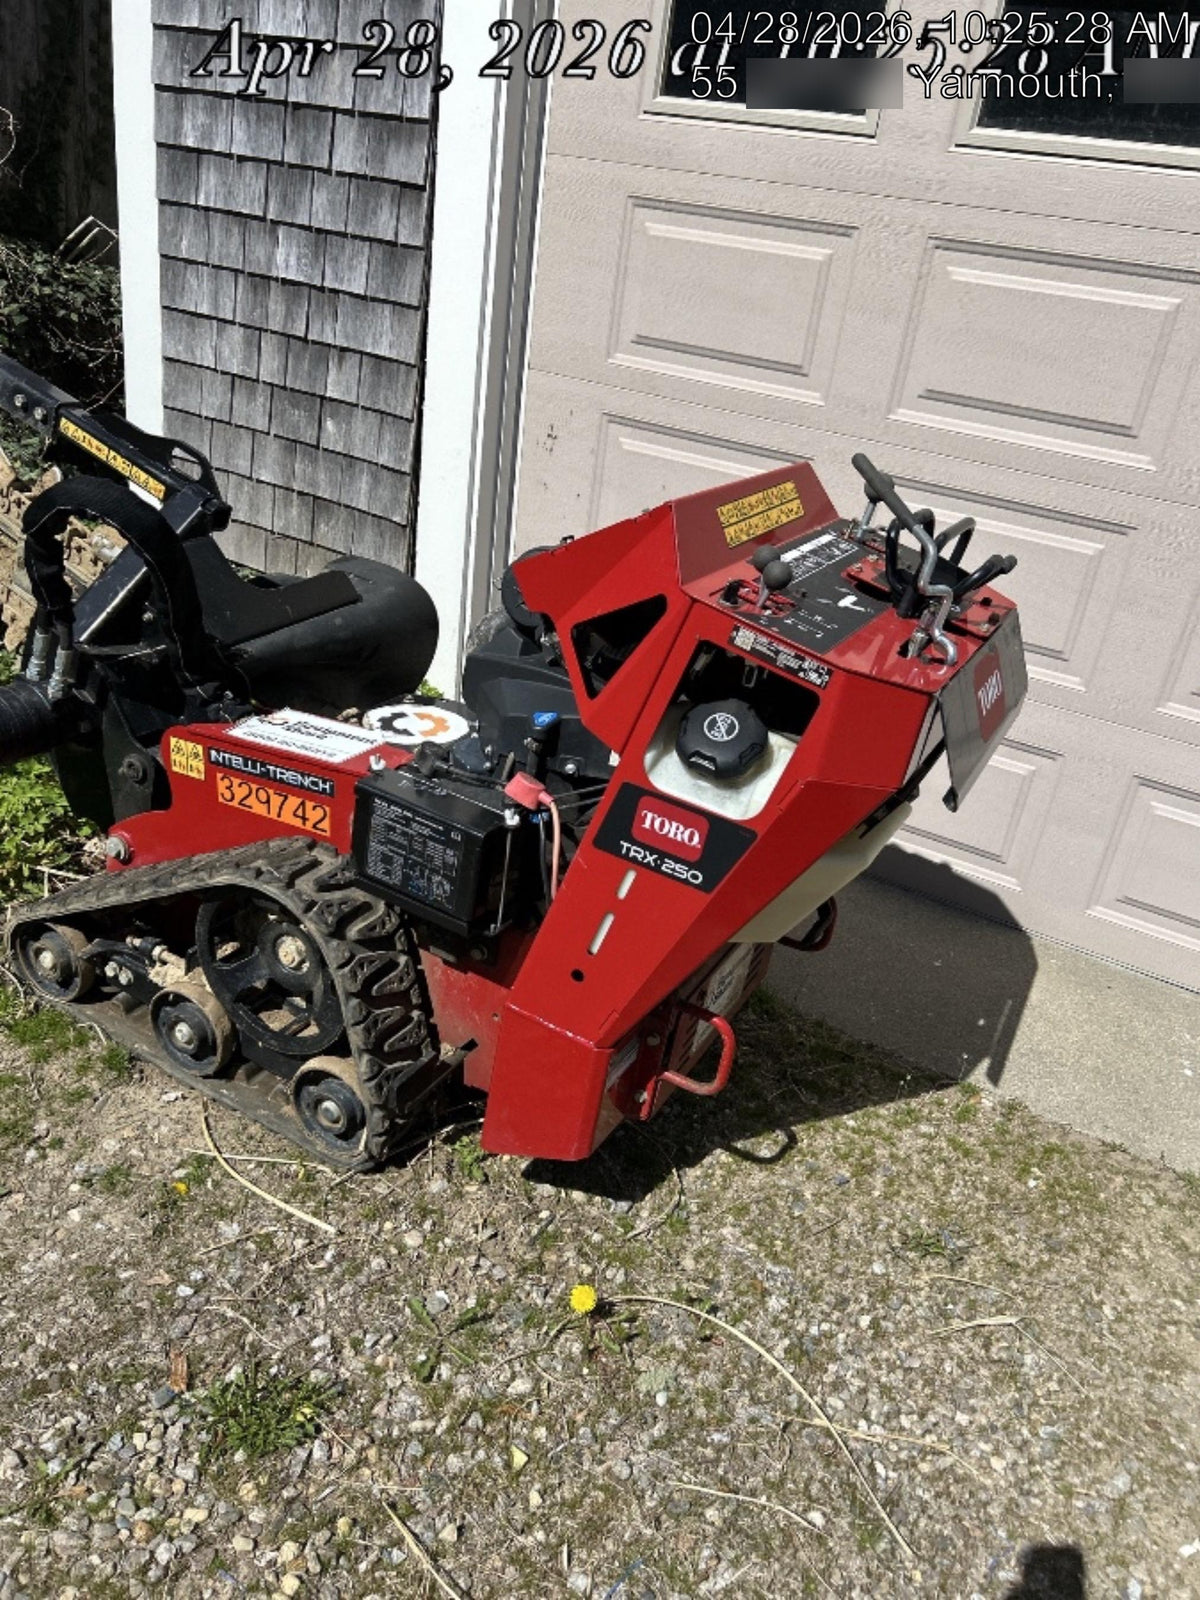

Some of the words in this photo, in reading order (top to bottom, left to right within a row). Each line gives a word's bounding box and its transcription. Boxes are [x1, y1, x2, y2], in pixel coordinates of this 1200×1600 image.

[210, 750, 331, 793] INTELLI-TRENCH
[219, 774, 328, 833] 329742
[641, 809, 701, 848] TORO
